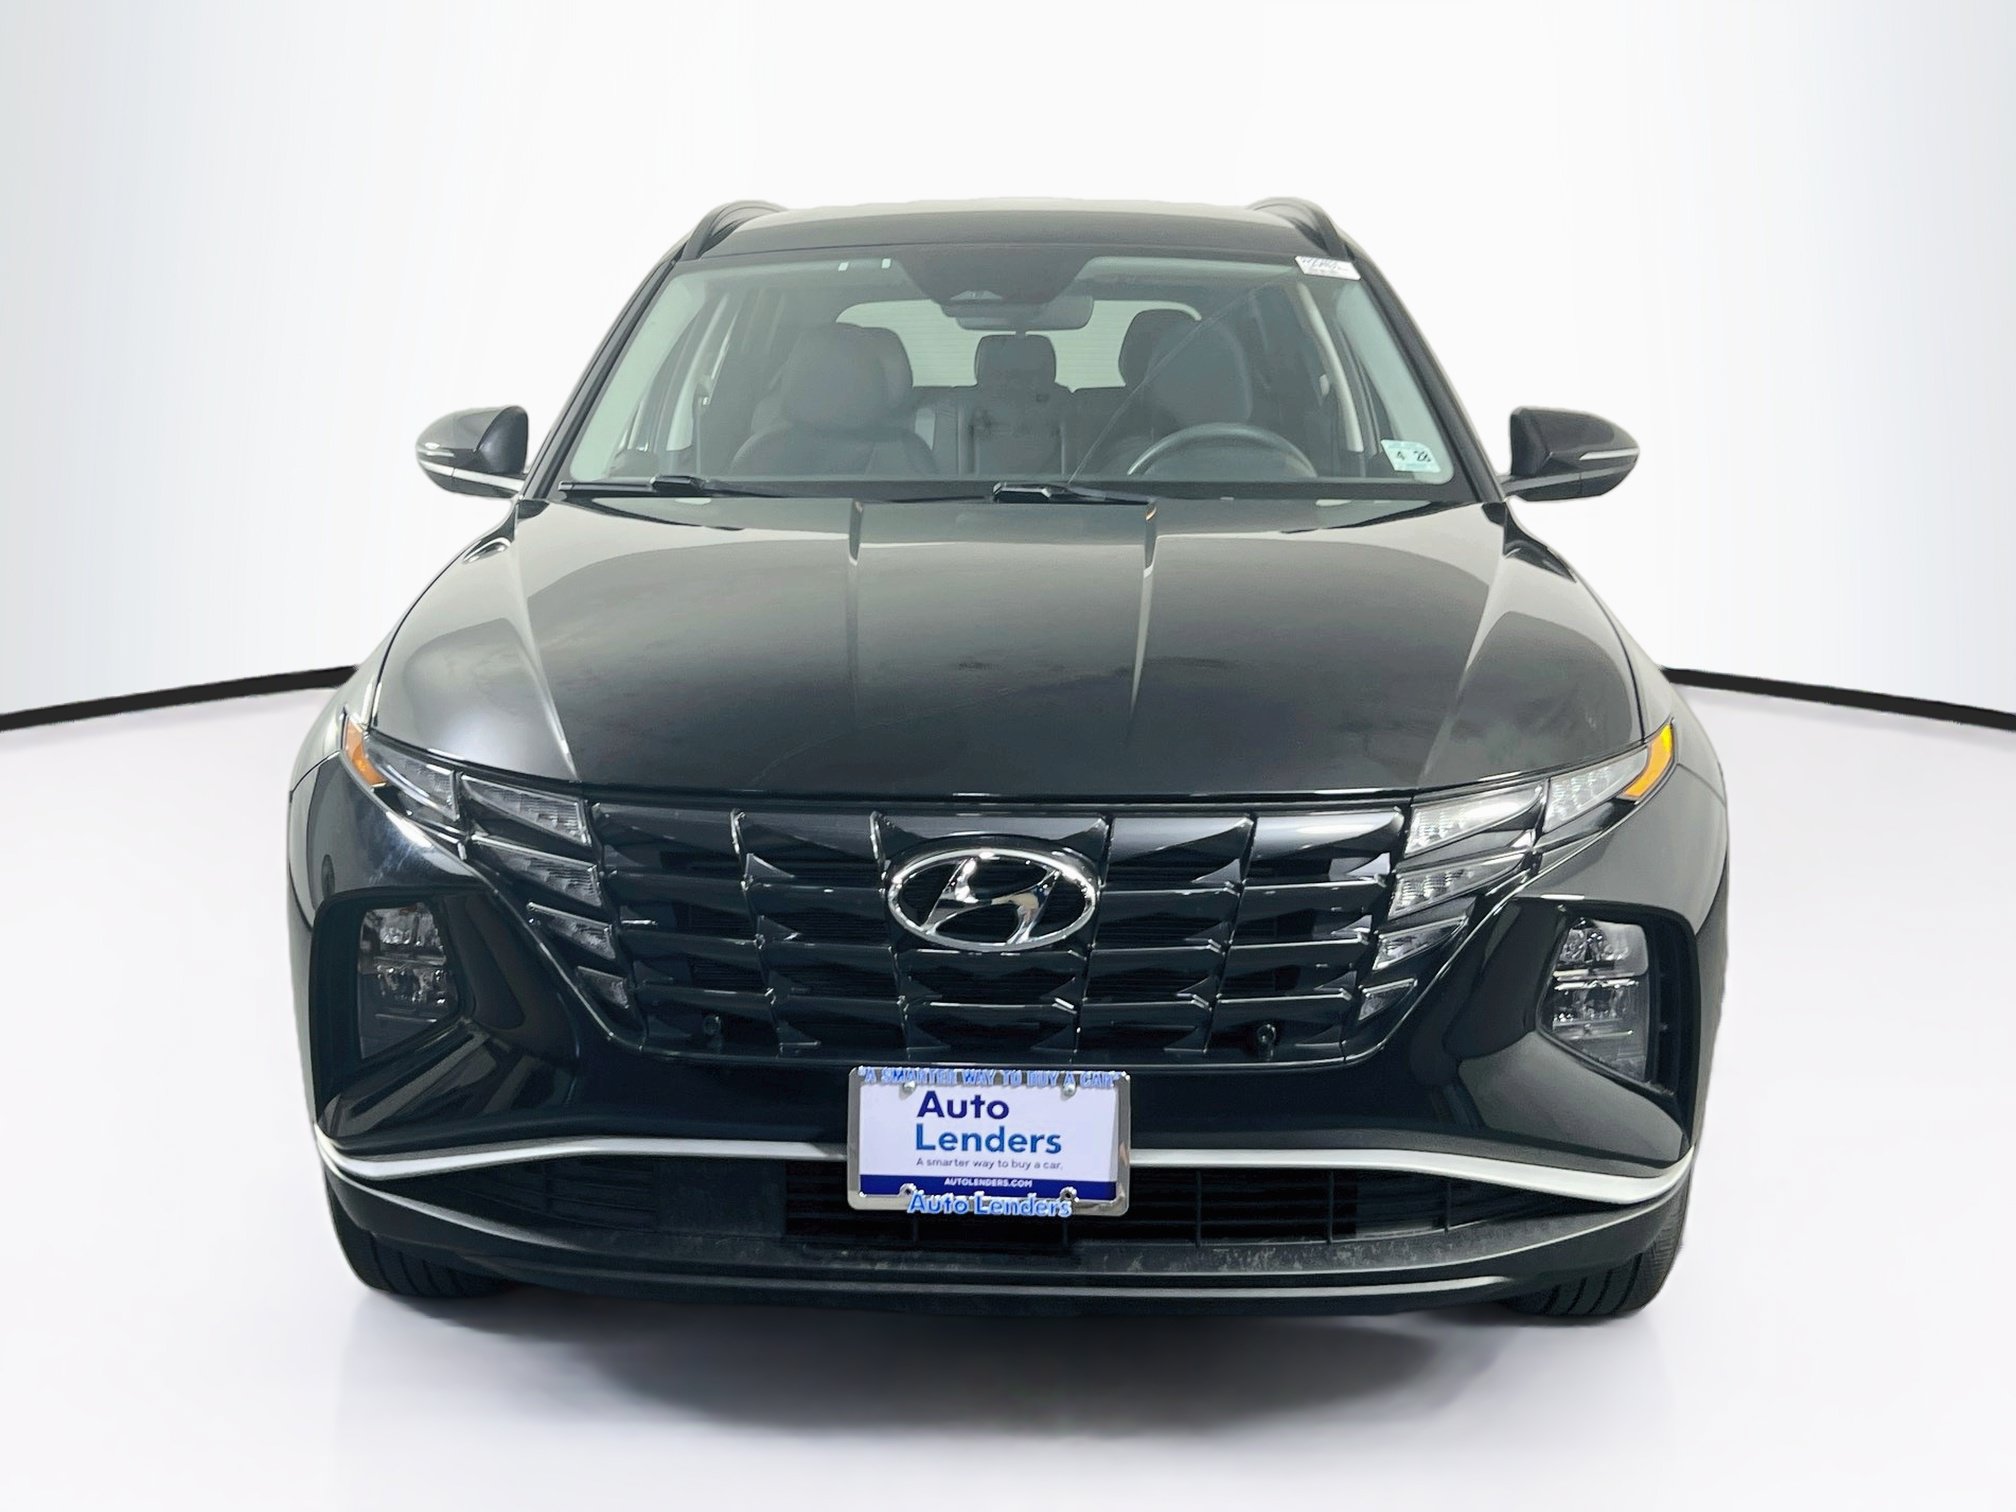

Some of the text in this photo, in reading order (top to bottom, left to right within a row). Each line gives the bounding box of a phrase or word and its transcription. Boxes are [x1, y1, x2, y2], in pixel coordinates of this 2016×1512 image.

[961, 1069, 996, 1086] WAY
[1000, 1070, 1022, 1086] TO
[1026, 1070, 1060, 1087] BUY
[917, 1090, 1010, 1119] Auto
[915, 1123, 1062, 1155] Lenders
[916, 1157, 924, 1167] A
[926, 1159, 969, 1168] smarter
[973, 1161, 995, 1170] way
[998, 1159, 1009, 1169] to
[1011, 1160, 1032, 1171] buy
[1034, 1162, 1042, 1170] a
[944, 1177, 1033, 1188] AUTOLENDERS.COM
[907, 1190, 1073, 1218] Auto Lenders
